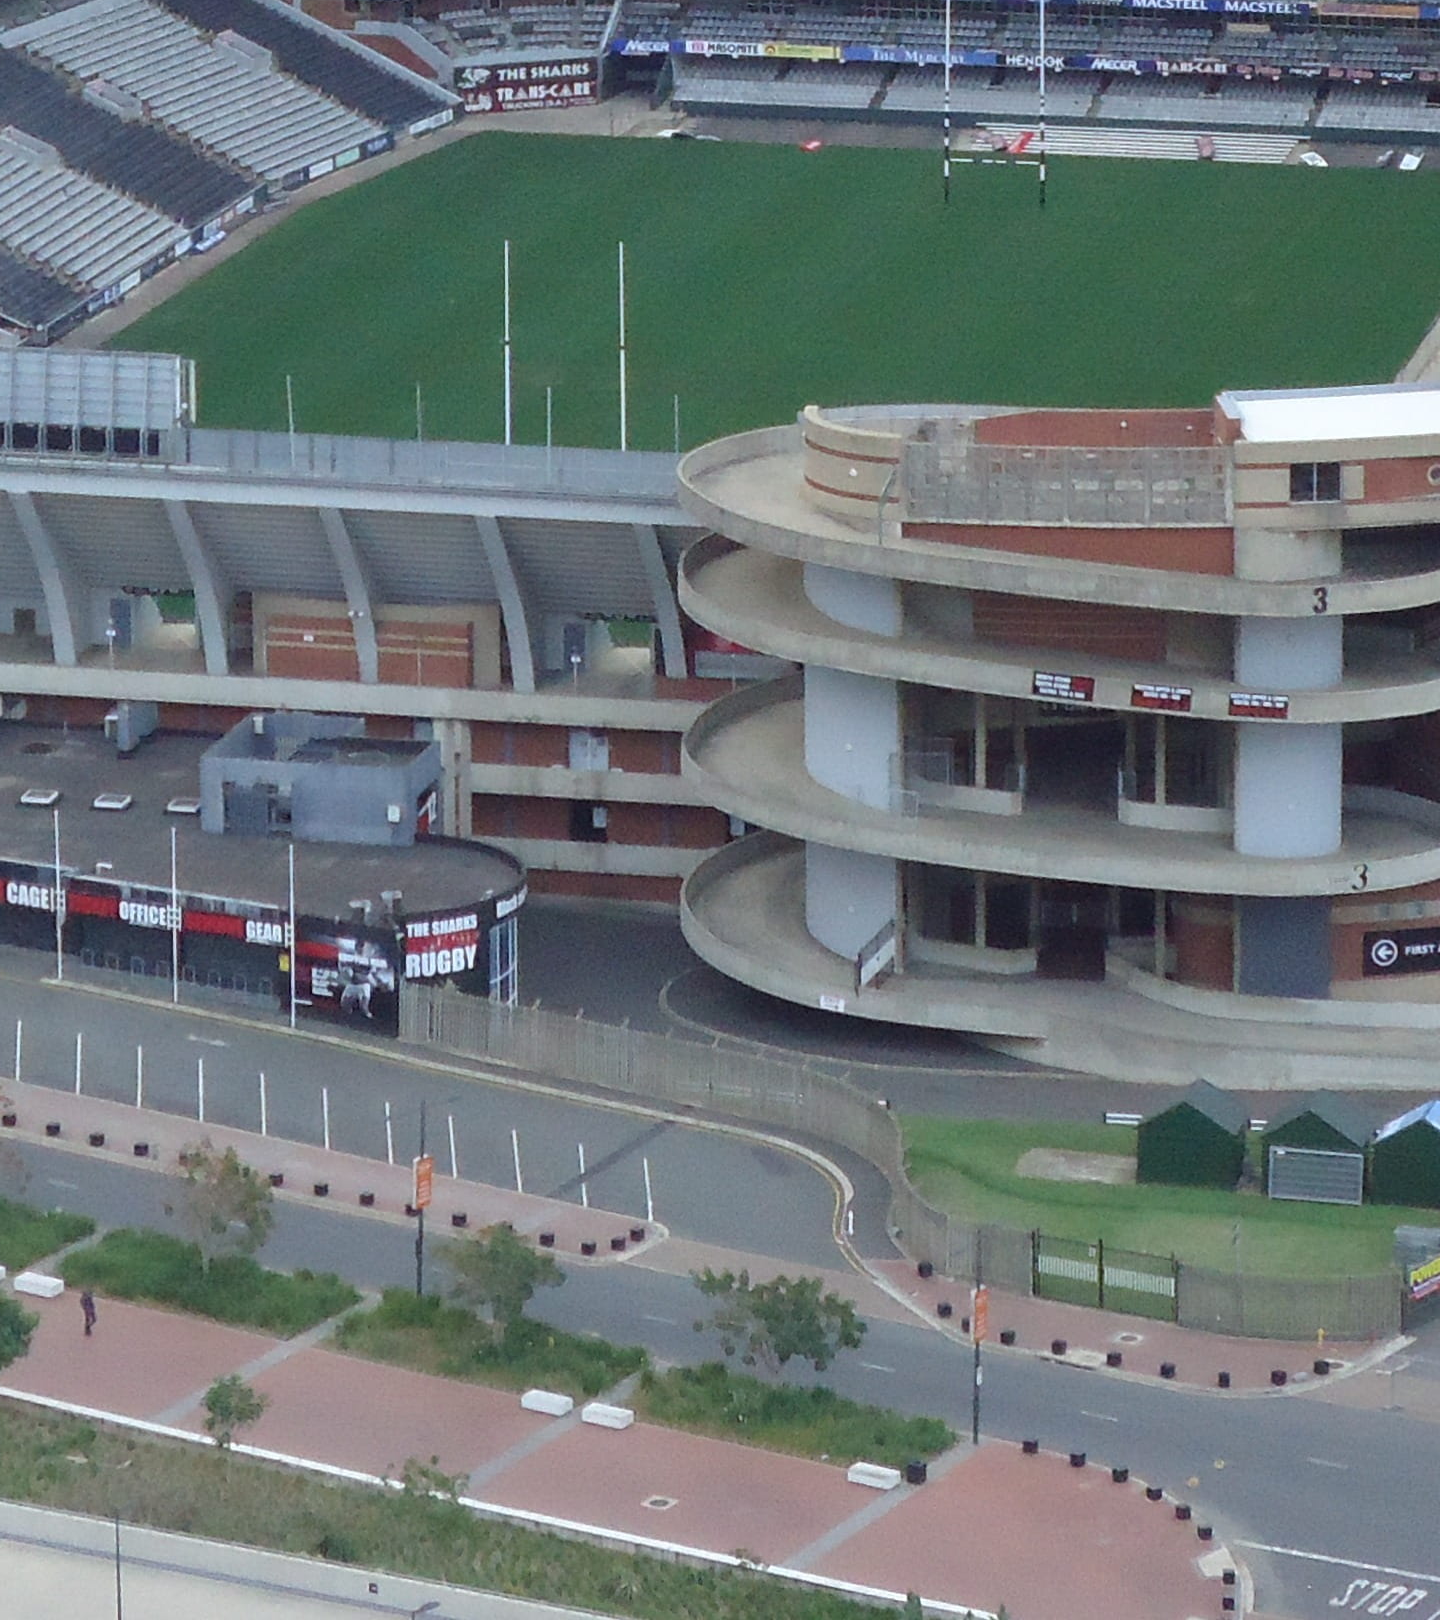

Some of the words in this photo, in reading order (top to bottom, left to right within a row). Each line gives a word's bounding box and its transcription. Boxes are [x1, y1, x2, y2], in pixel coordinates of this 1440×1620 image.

[707, 43, 759, 54] MASONITE
[497, 67, 527, 81] THE
[530, 62, 590, 80] SHARKS
[1006, 55, 1065, 68] HENDOK
[496, 81, 591, 102] TRANS-CARE
[1312, 586, 1328, 614] 3
[1351, 863, 1368, 891] 3
[6, 882, 49, 909] CAGE
[118, 901, 167, 927] OFFICE
[406, 922, 429, 938] THE
[431, 913, 478, 936] SHARKS
[245, 920, 282, 943] GEAR
[405, 944, 478, 979] RUGBY
[1404, 942, 1435, 956] FIRST
[1328, 1579, 1429, 1618] STOP
